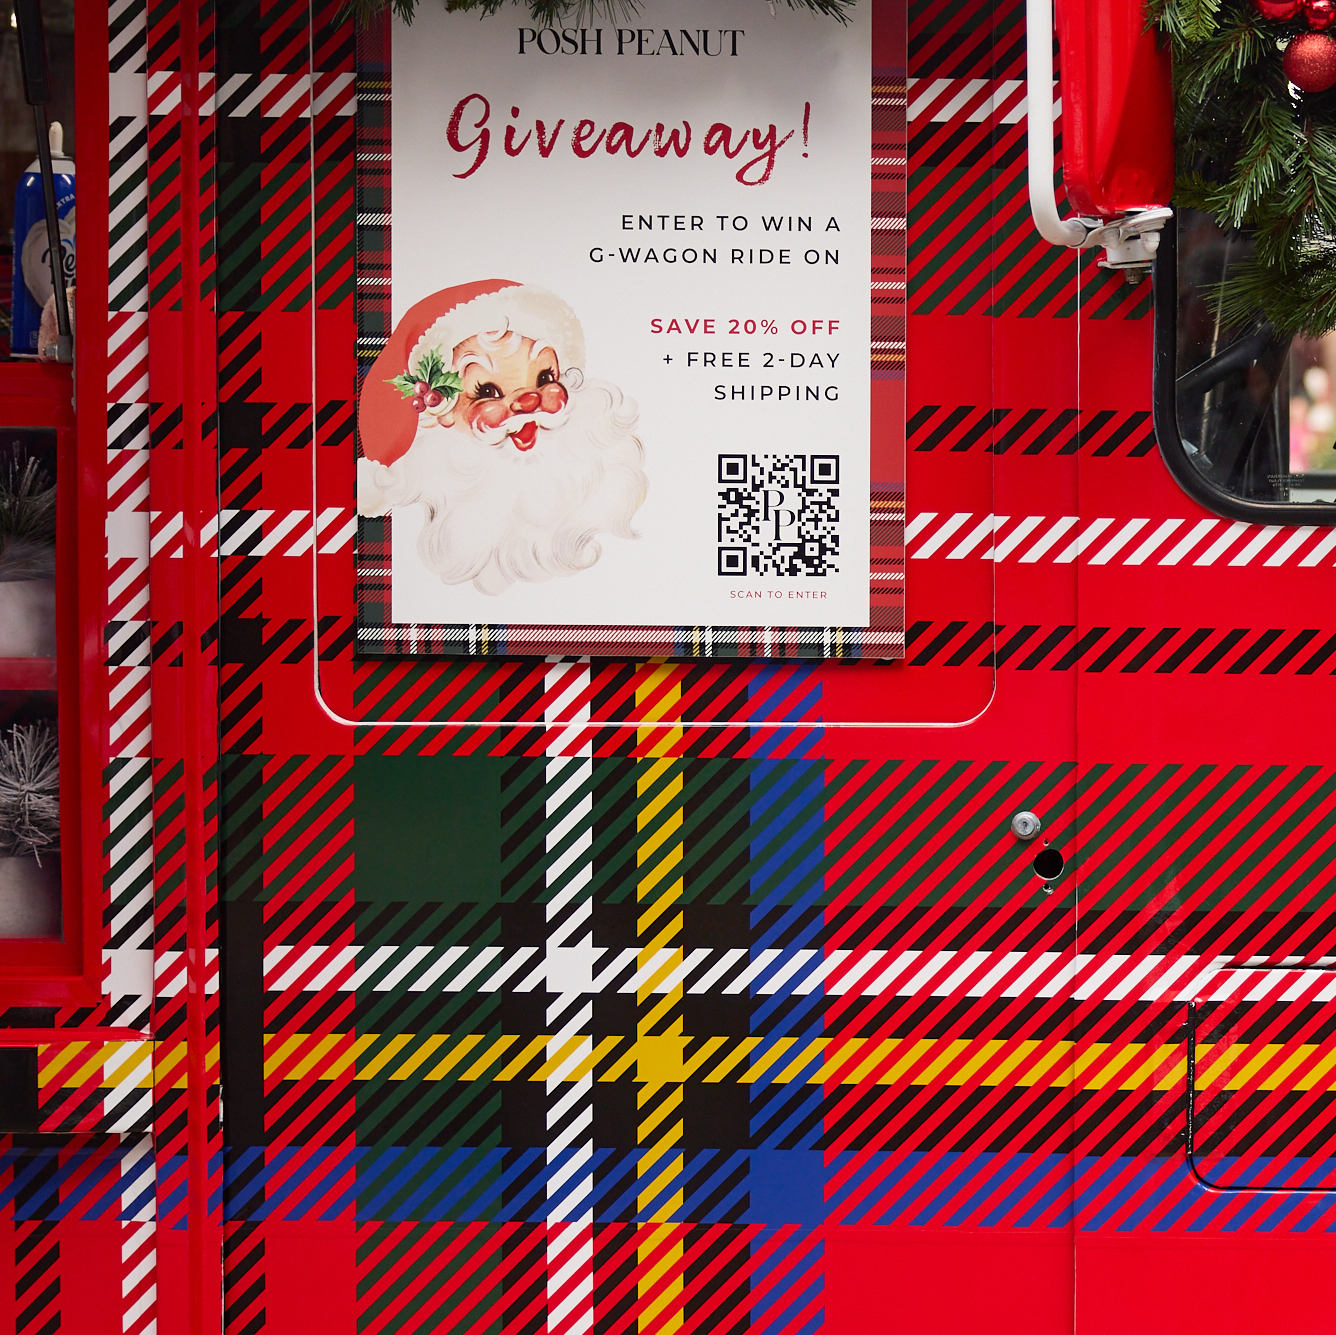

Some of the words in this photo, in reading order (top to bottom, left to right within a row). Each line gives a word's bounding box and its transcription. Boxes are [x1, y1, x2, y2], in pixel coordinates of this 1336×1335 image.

[518, 27, 603, 55] POSH
[617, 28, 745, 57] PEANUT
[445, 92, 811, 187] Giveaway!
[622, 214, 704, 231] ENTER
[715, 215, 749, 232] TO
[761, 215, 812, 232] WIN
[824, 216, 841, 232] A
[589, 247, 717, 264] G-WAGON
[731, 248, 791, 265] RIDE
[803, 249, 839, 265] ON
[650, 318, 716, 335] SAVE
[728, 318, 778, 335] 20%
[790, 319, 840, 336] OFF
[687, 351, 750, 368] FREE
[762, 352, 840, 369] 2-DAY
[714, 384, 839, 402] SHIPPING
[730, 590, 762, 599] SCAN
[767, 590, 783, 599] TO
[788, 590, 828, 599] ENTER
